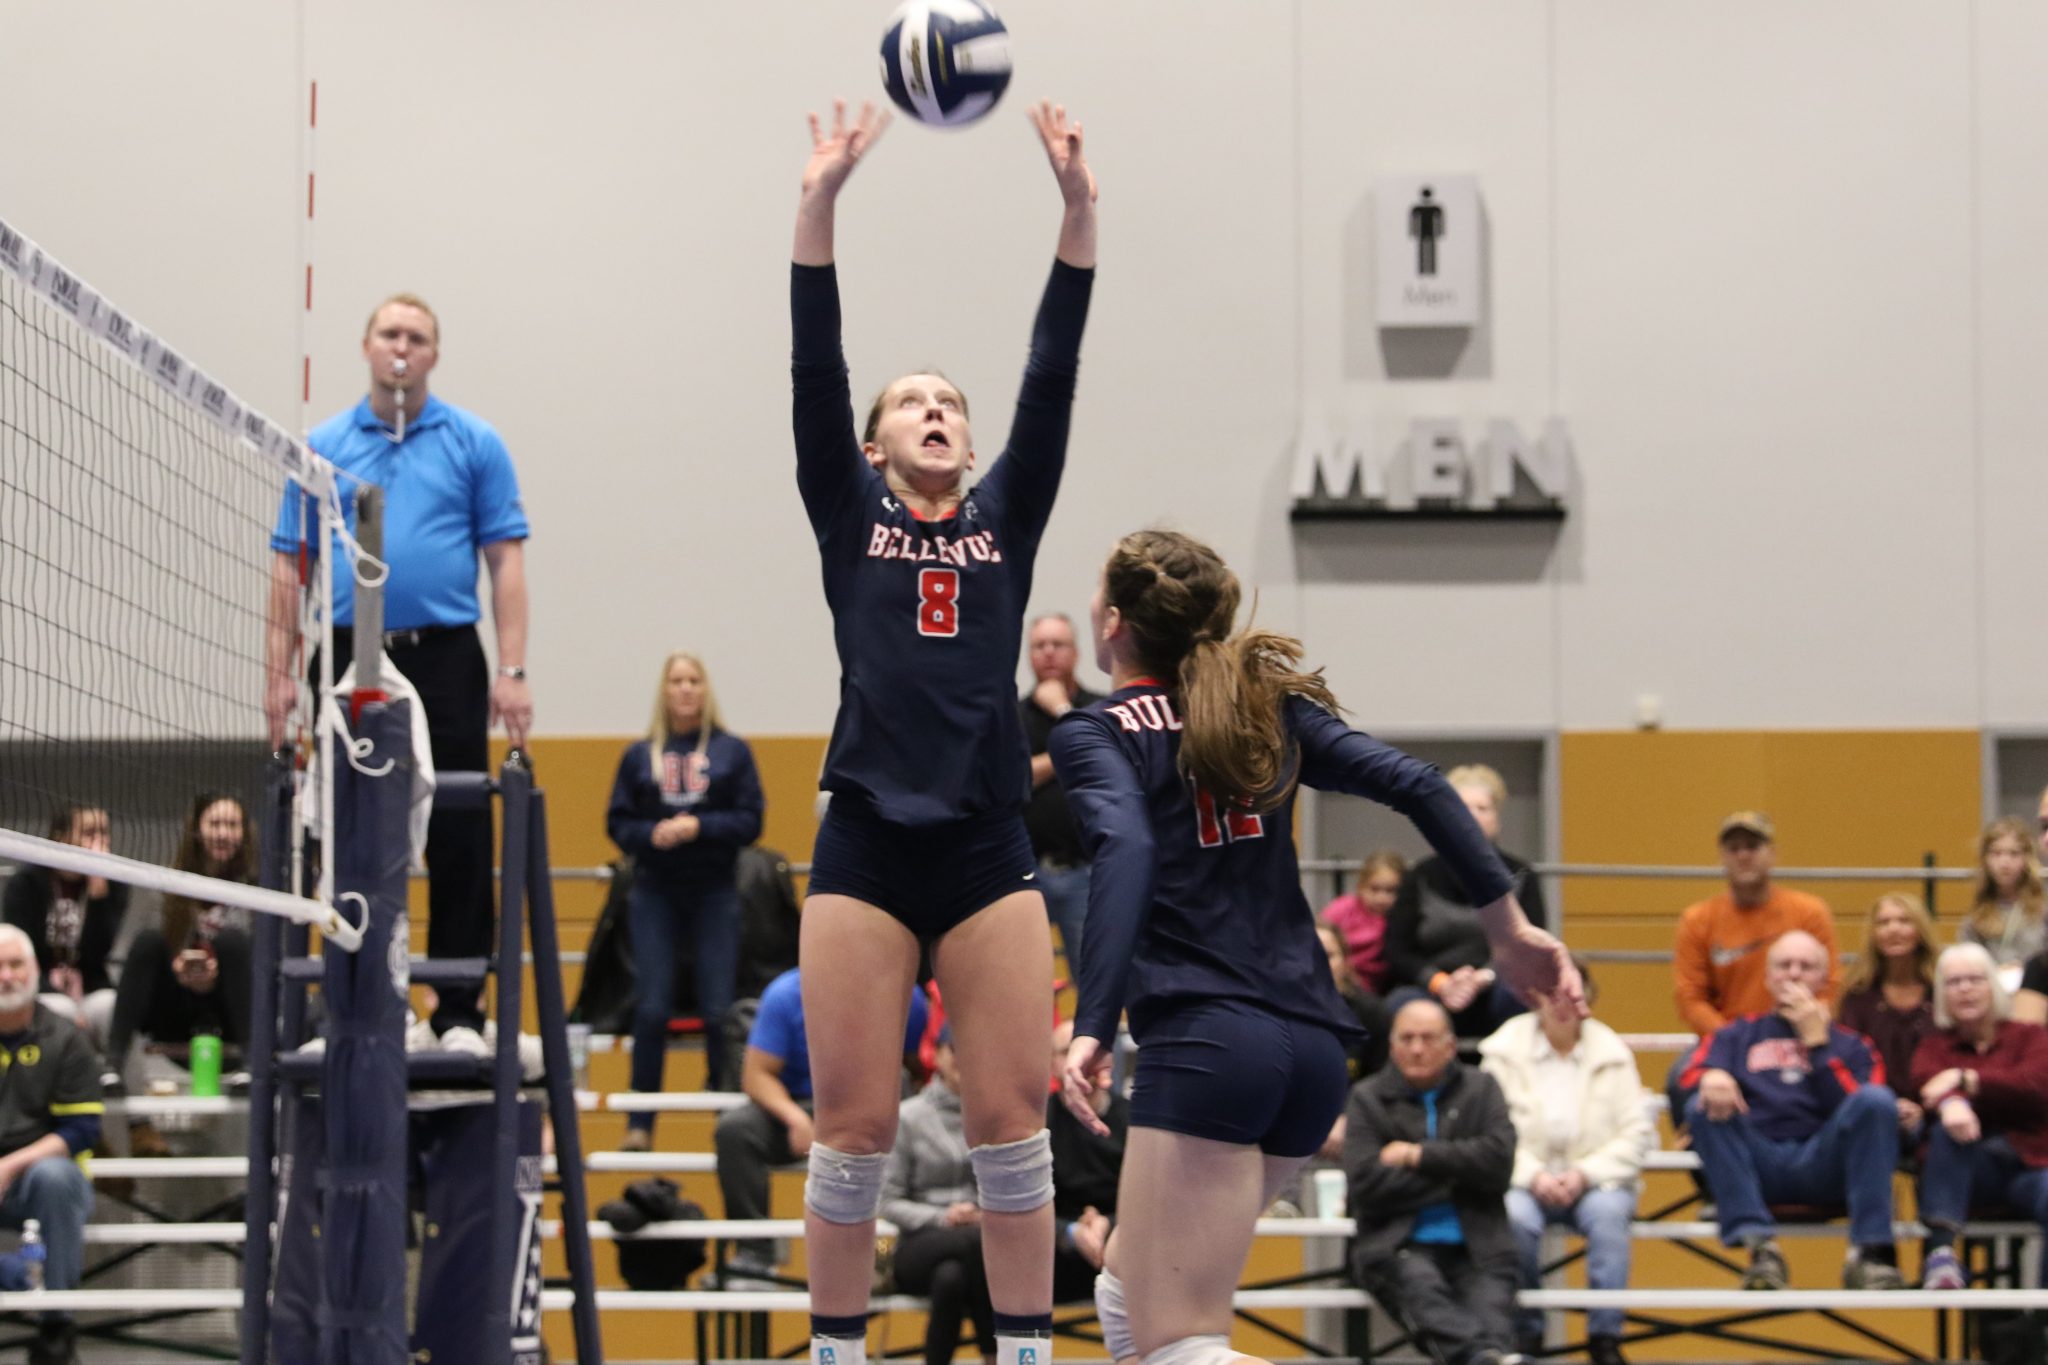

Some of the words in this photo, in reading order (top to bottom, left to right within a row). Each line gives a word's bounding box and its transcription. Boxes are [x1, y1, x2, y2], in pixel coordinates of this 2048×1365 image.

[1292, 415, 1570, 506] MEN
[867, 522, 1002, 567] BELLEVUE
[917, 567, 960, 638] 8
[1104, 694, 1184, 733] BUL
